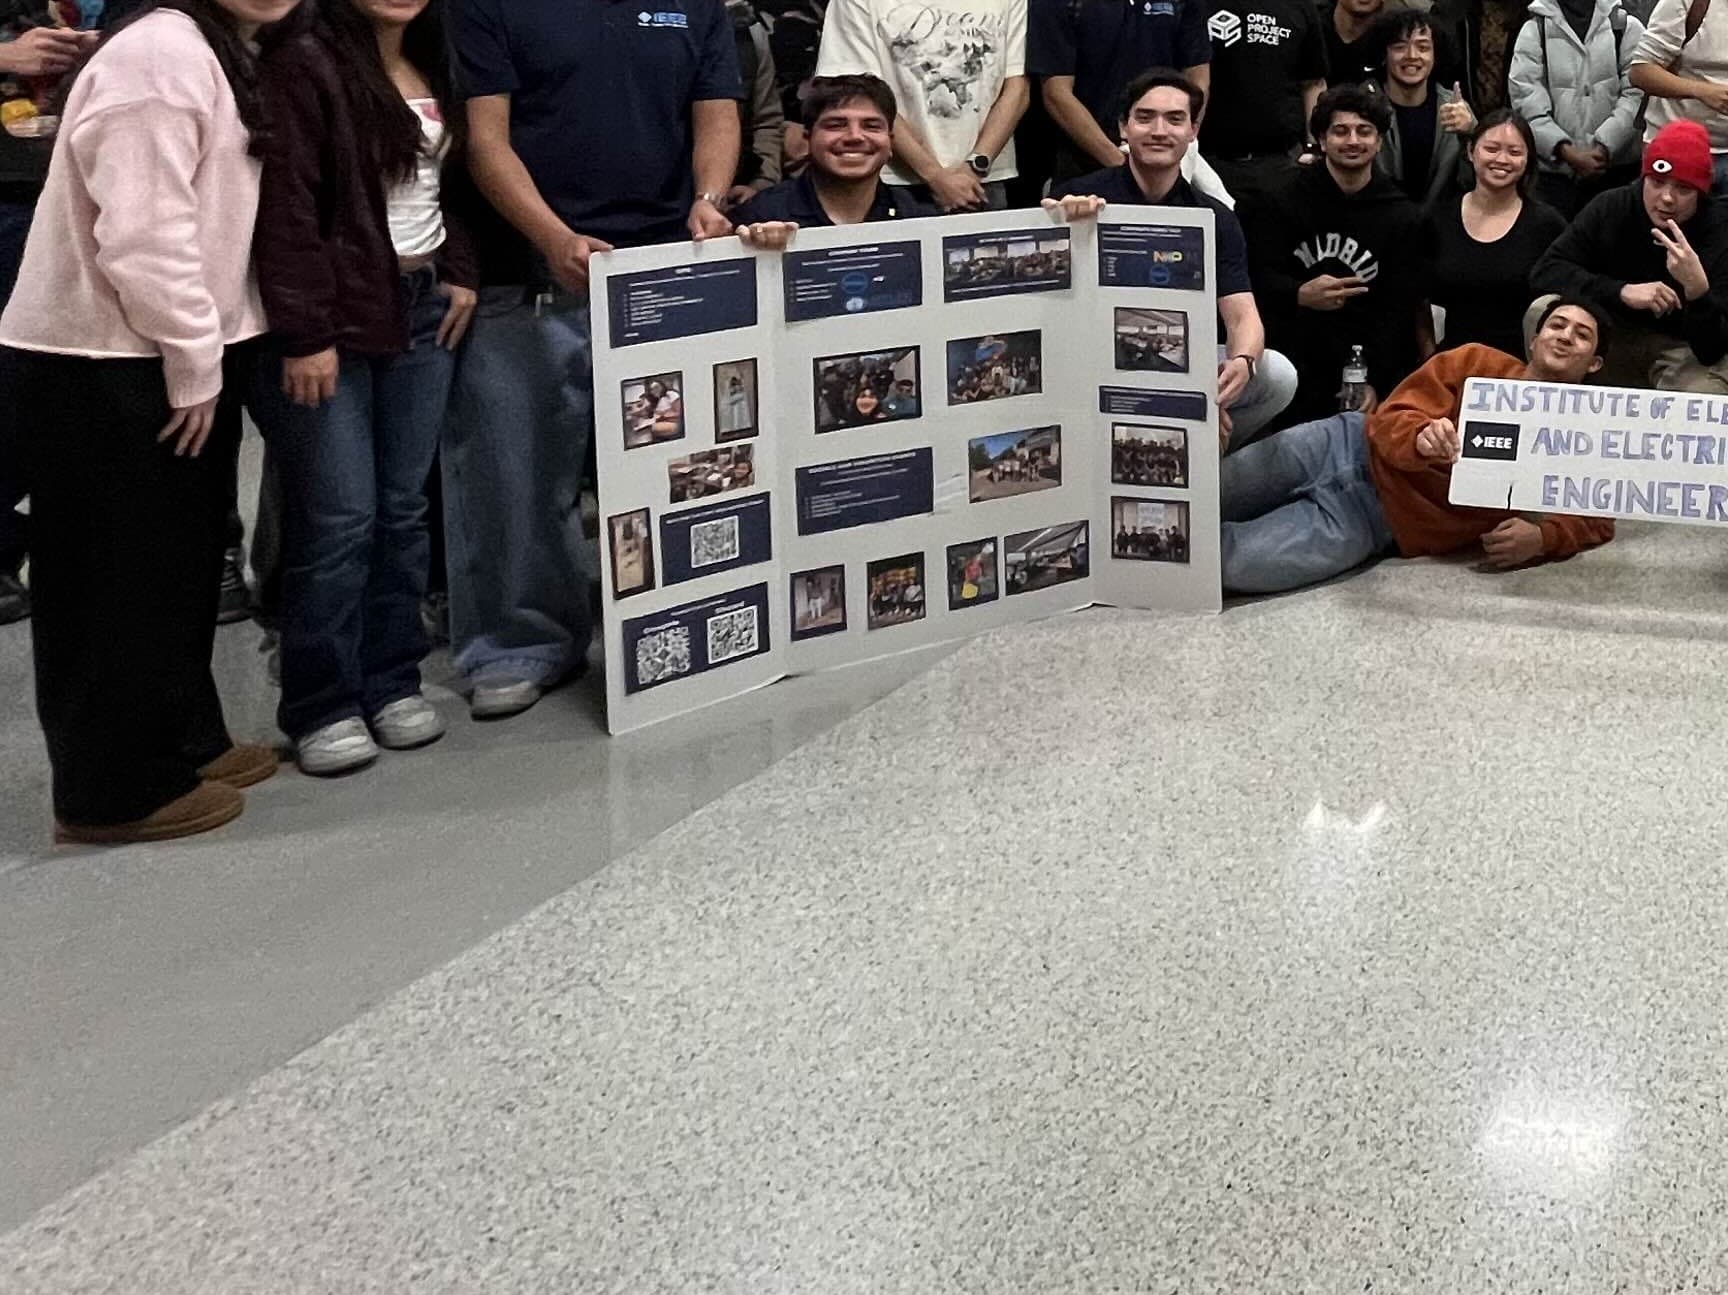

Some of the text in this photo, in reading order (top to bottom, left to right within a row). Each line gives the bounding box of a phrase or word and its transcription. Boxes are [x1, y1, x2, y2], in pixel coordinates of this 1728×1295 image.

[1247, 13, 1276, 25] OPEN
[1247, 23, 1292, 39] PROJECT
[1247, 33, 1279, 45] SPACE
[1467, 382, 1641, 418] INSTITUTE
[1650, 397, 1675, 420] OF
[1484, 436, 1513, 450] IEEE
[1530, 427, 1594, 456] AND
